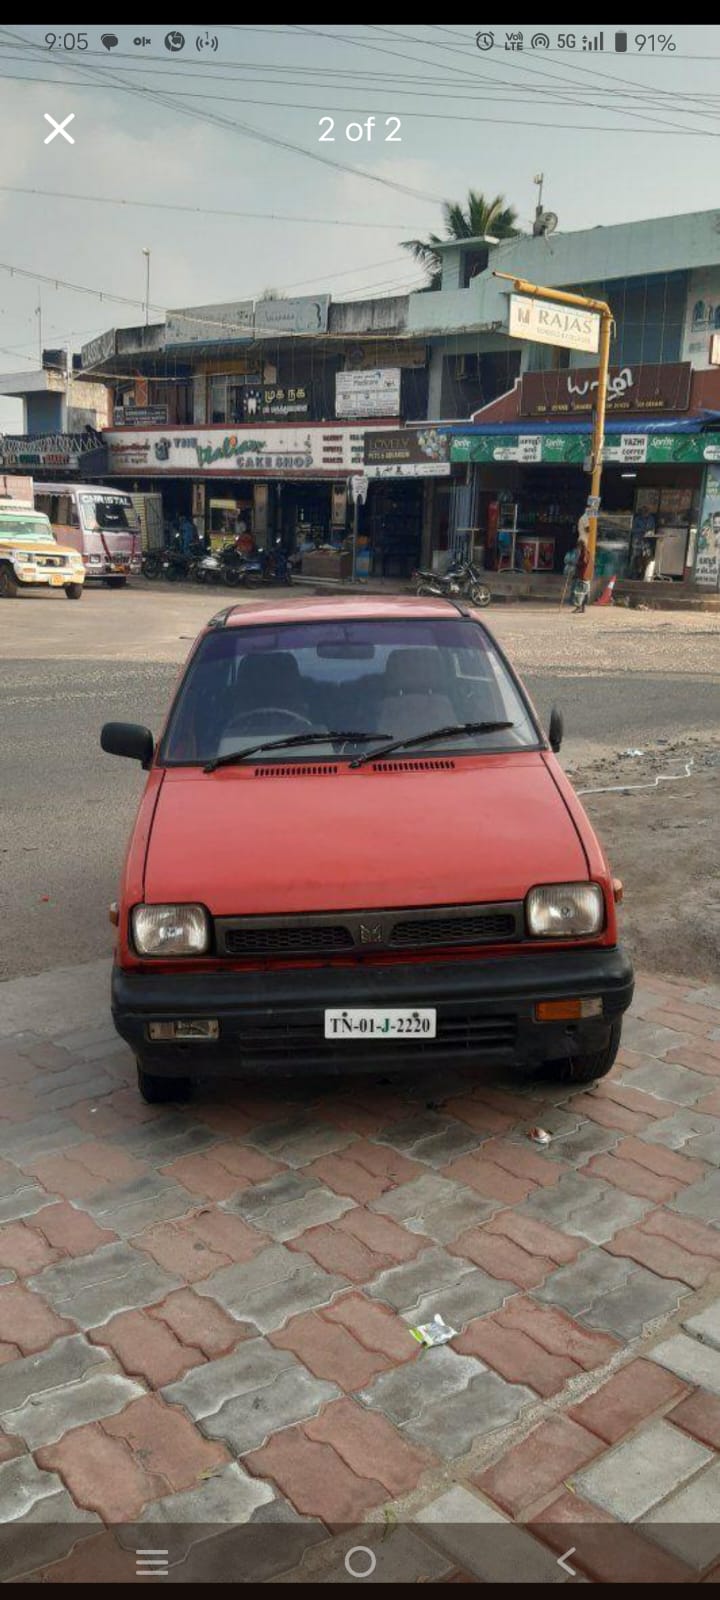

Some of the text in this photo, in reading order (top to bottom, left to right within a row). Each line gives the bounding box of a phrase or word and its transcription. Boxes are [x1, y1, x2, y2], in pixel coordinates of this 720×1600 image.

[538, 310, 592, 334] RAJAS
[623, 437, 645, 446] YAZHI
[650, 436, 674, 447] Sprite
[237, 456, 314, 468] CAKE SHOP
[329, 1018, 430, 1033] TN-01-J-2220
